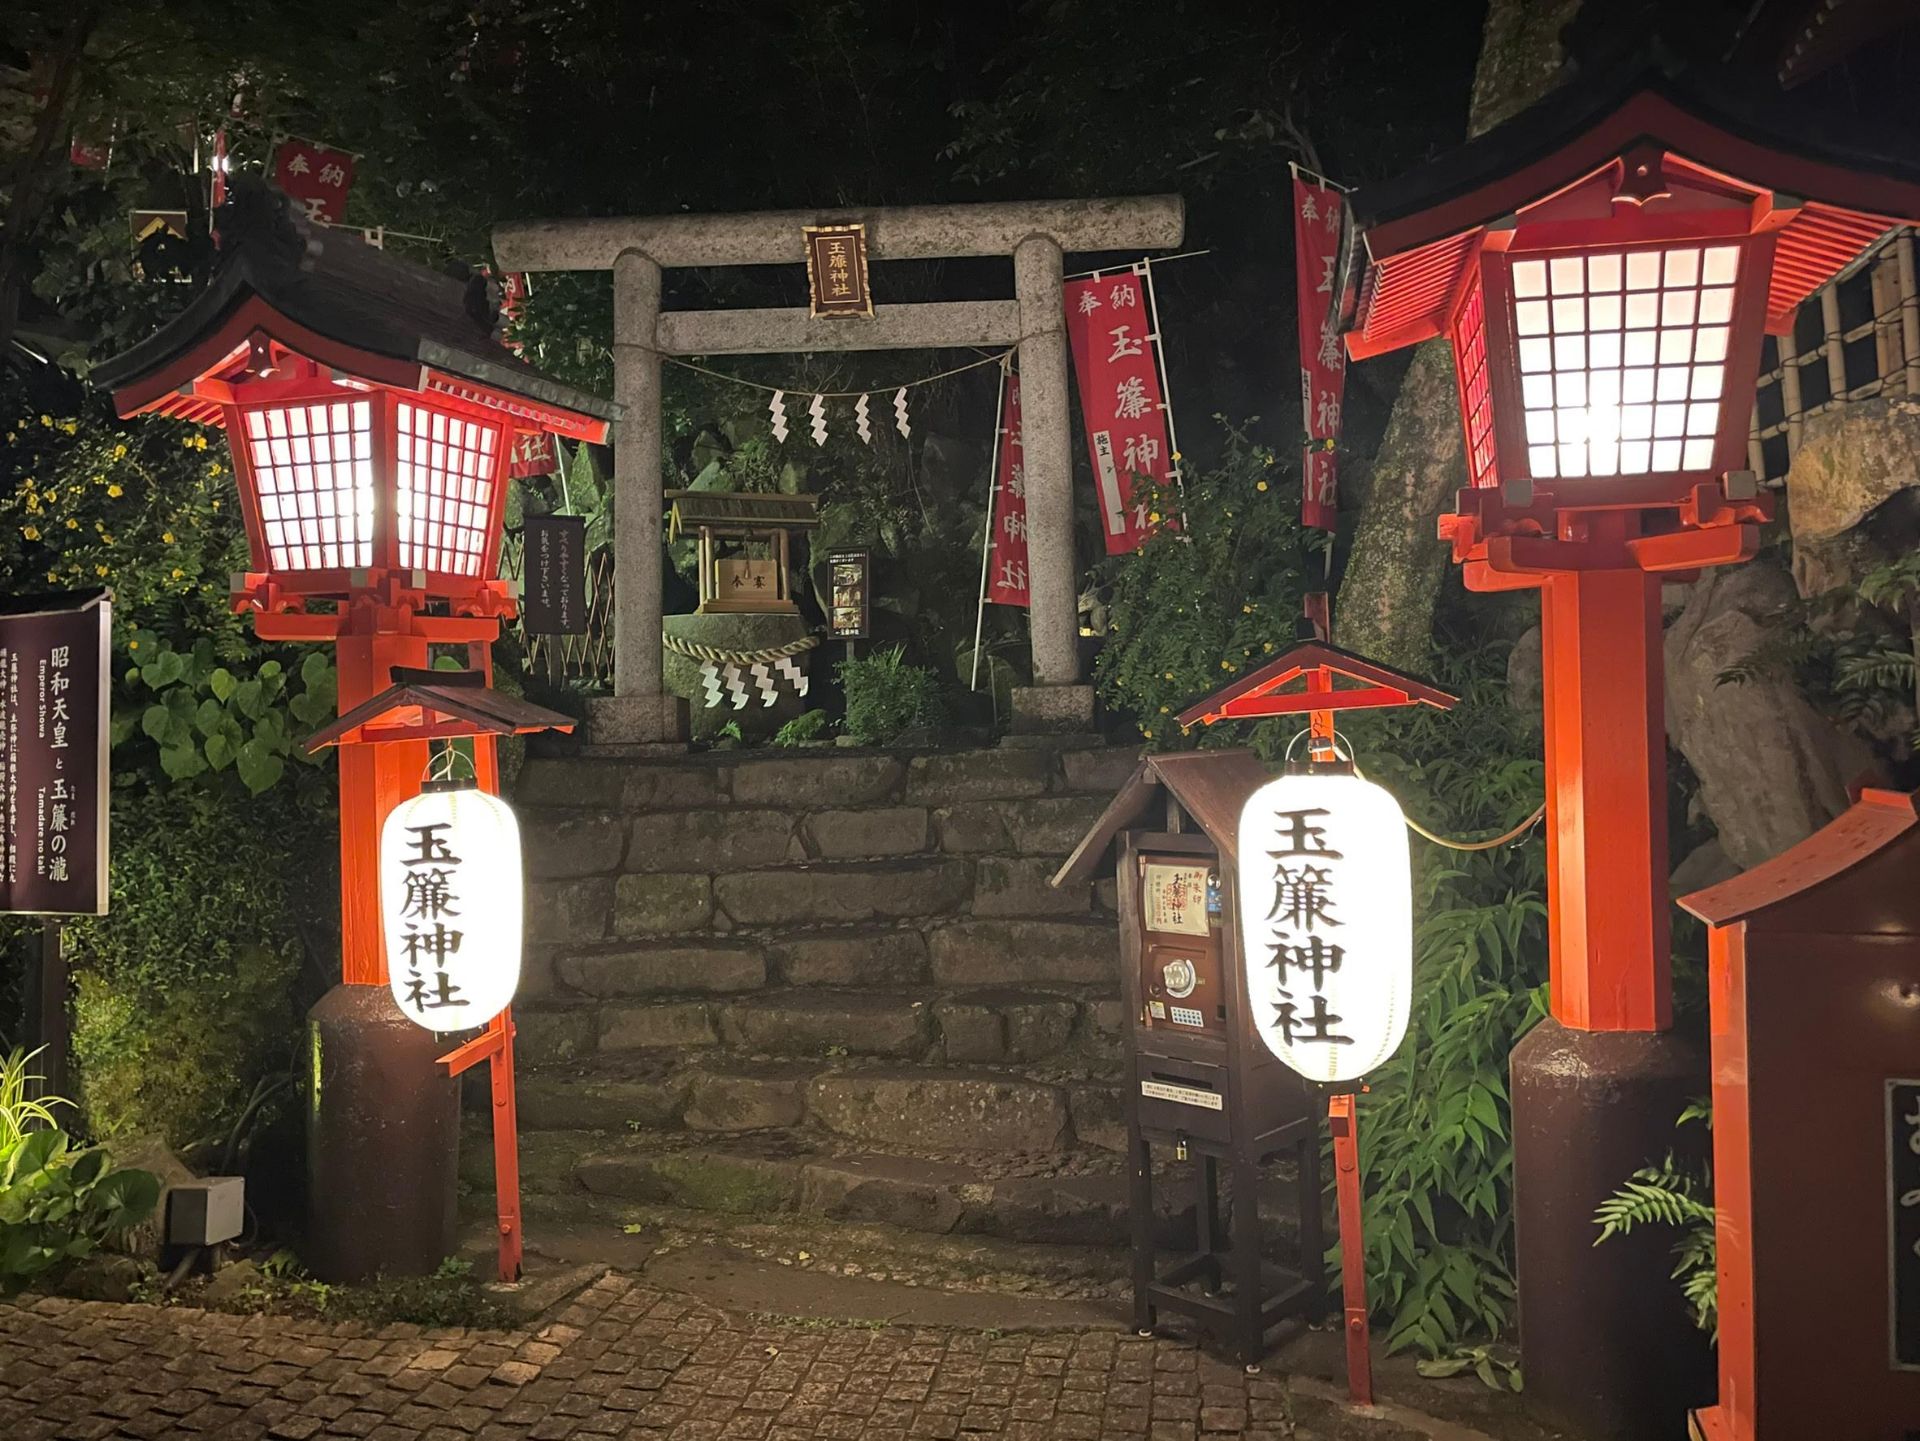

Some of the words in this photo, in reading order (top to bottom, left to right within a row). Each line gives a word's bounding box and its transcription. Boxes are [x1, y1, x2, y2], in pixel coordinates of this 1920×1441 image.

[287, 153, 345, 188] 奉納
[828, 241, 851, 297] 玉簾神社
[1078, 284, 1136, 317] 奉納
[38, 659, 47, 702] Emperor
[38, 704, 47, 738] Showa
[37, 786, 46, 837] Tamadare
[37, 839, 44, 853] no
[37, 855, 46, 875] taki
[400, 822, 471, 1013] 玉簾神社
[1263, 808, 1355, 1047] 玉簾神社
